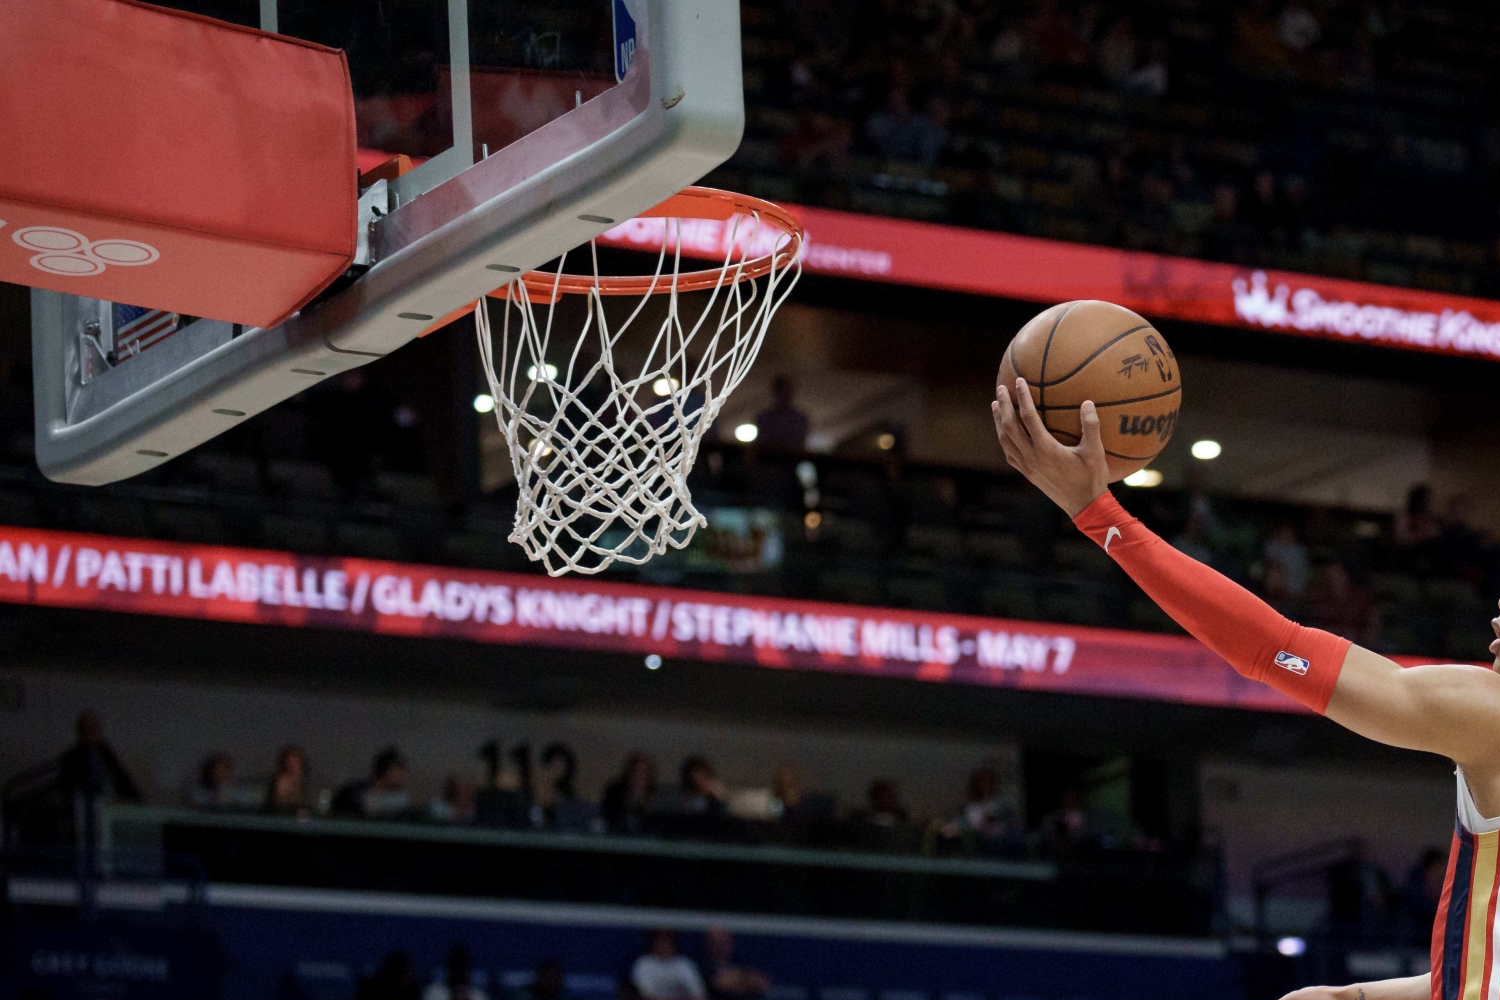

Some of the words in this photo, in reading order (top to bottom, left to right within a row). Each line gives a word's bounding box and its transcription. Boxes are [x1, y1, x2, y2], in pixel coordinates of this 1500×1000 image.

[1292, 289, 1437, 347] SMOOTHIE
[75, 547, 184, 597] PATTI
[187, 557, 348, 611] LABELLE
[371, 574, 514, 625] GLADYS
[516, 587, 651, 637] KNIGHT
[672, 601, 859, 656] STEPHANIE
[860, 619, 960, 664] MILLS
[1051, 635, 1076, 675] 7
